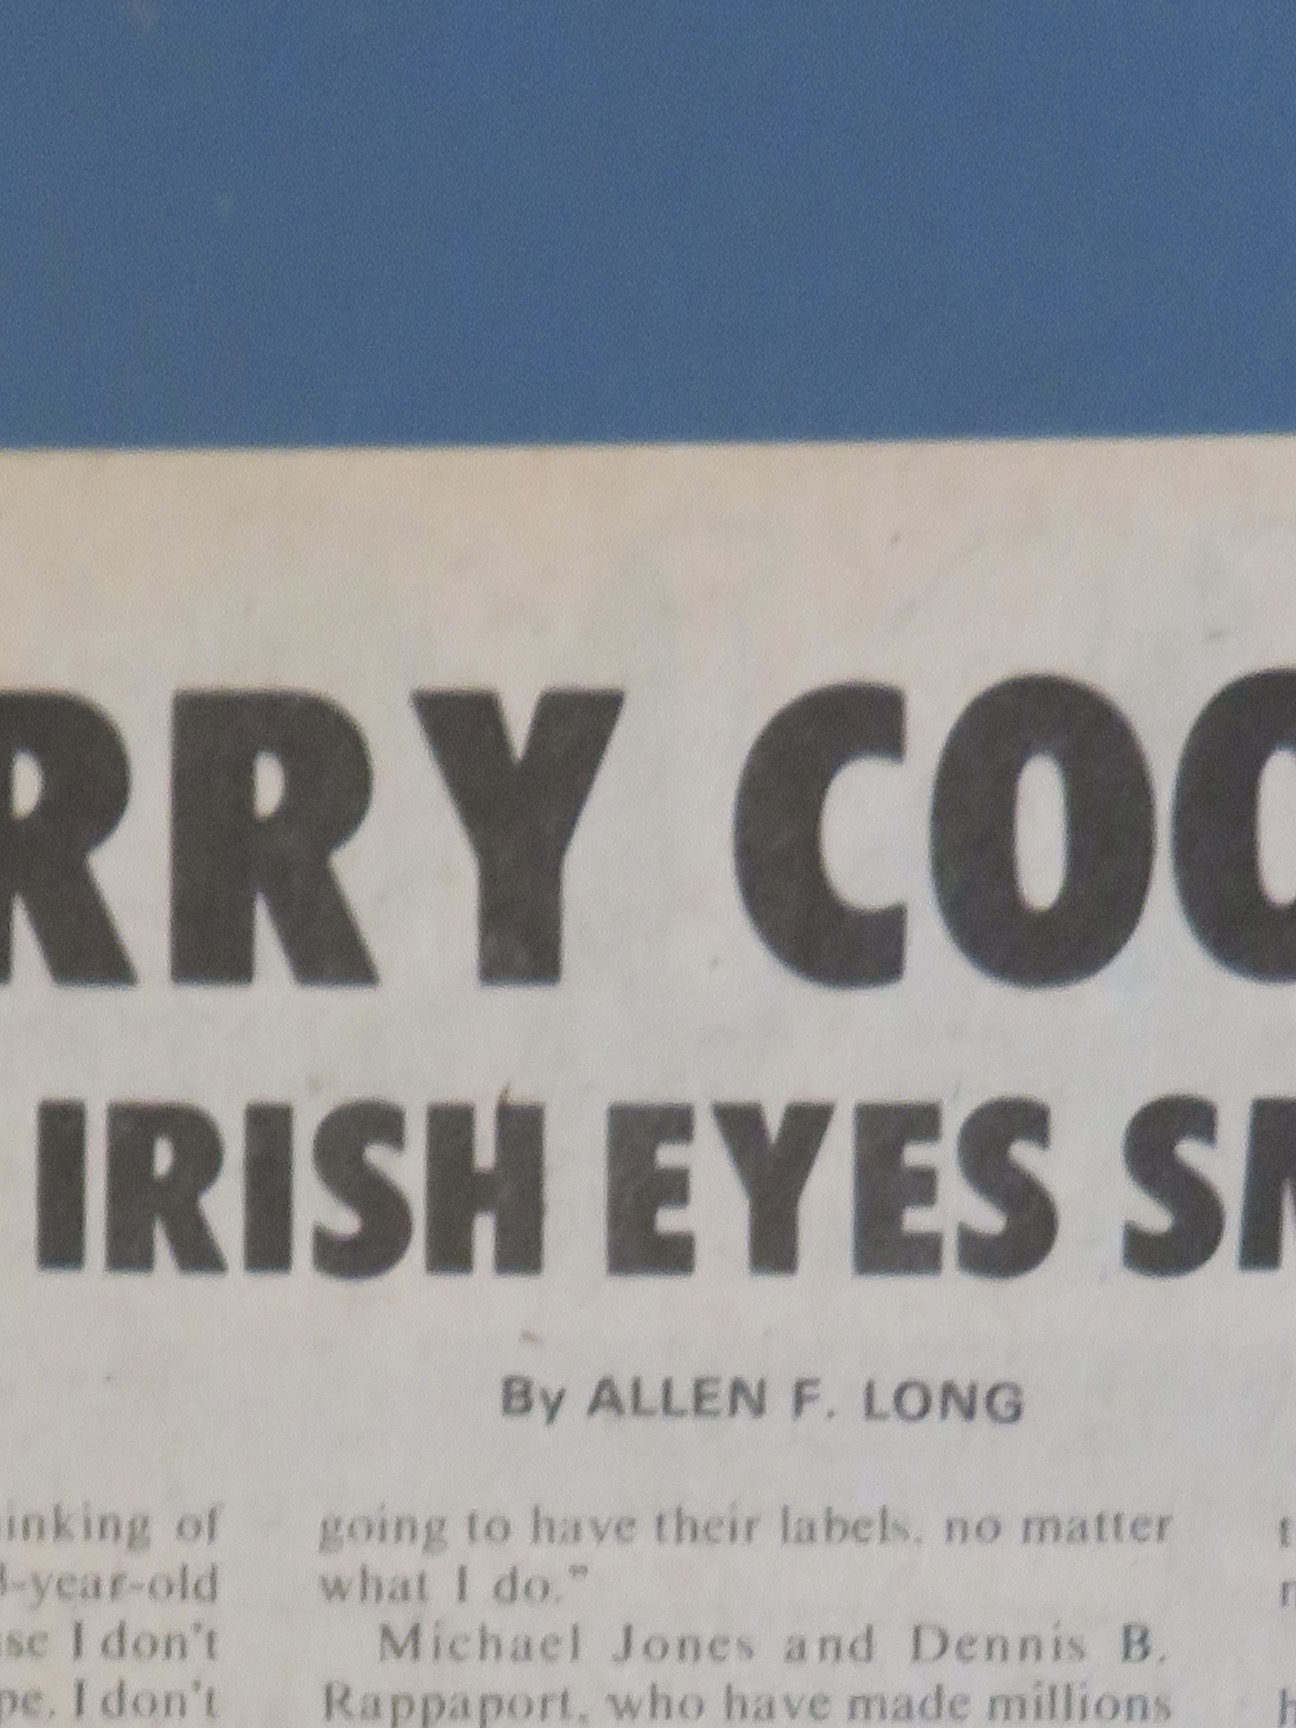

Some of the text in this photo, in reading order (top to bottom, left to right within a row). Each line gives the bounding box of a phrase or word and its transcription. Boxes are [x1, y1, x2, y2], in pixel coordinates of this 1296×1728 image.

[35, 1098, 546, 1281] IRISH
[604, 1096, 1060, 1281] EYES
[499, 1372, 1026, 1428] By ALLEN F. LONG
[173, 1503, 221, 1547] of
[69, 1616, 87, 1664] I
[98, 1617, 220, 1664] don't
[376, 1617, 1168, 1667] Michael Jones and Dennis B.
[603, 1679, 708, 1724] who
[721, 1680, 833, 1725] have
[845, 1680, 973, 1725] made
[984, 1677, 1175, 1725] millions
